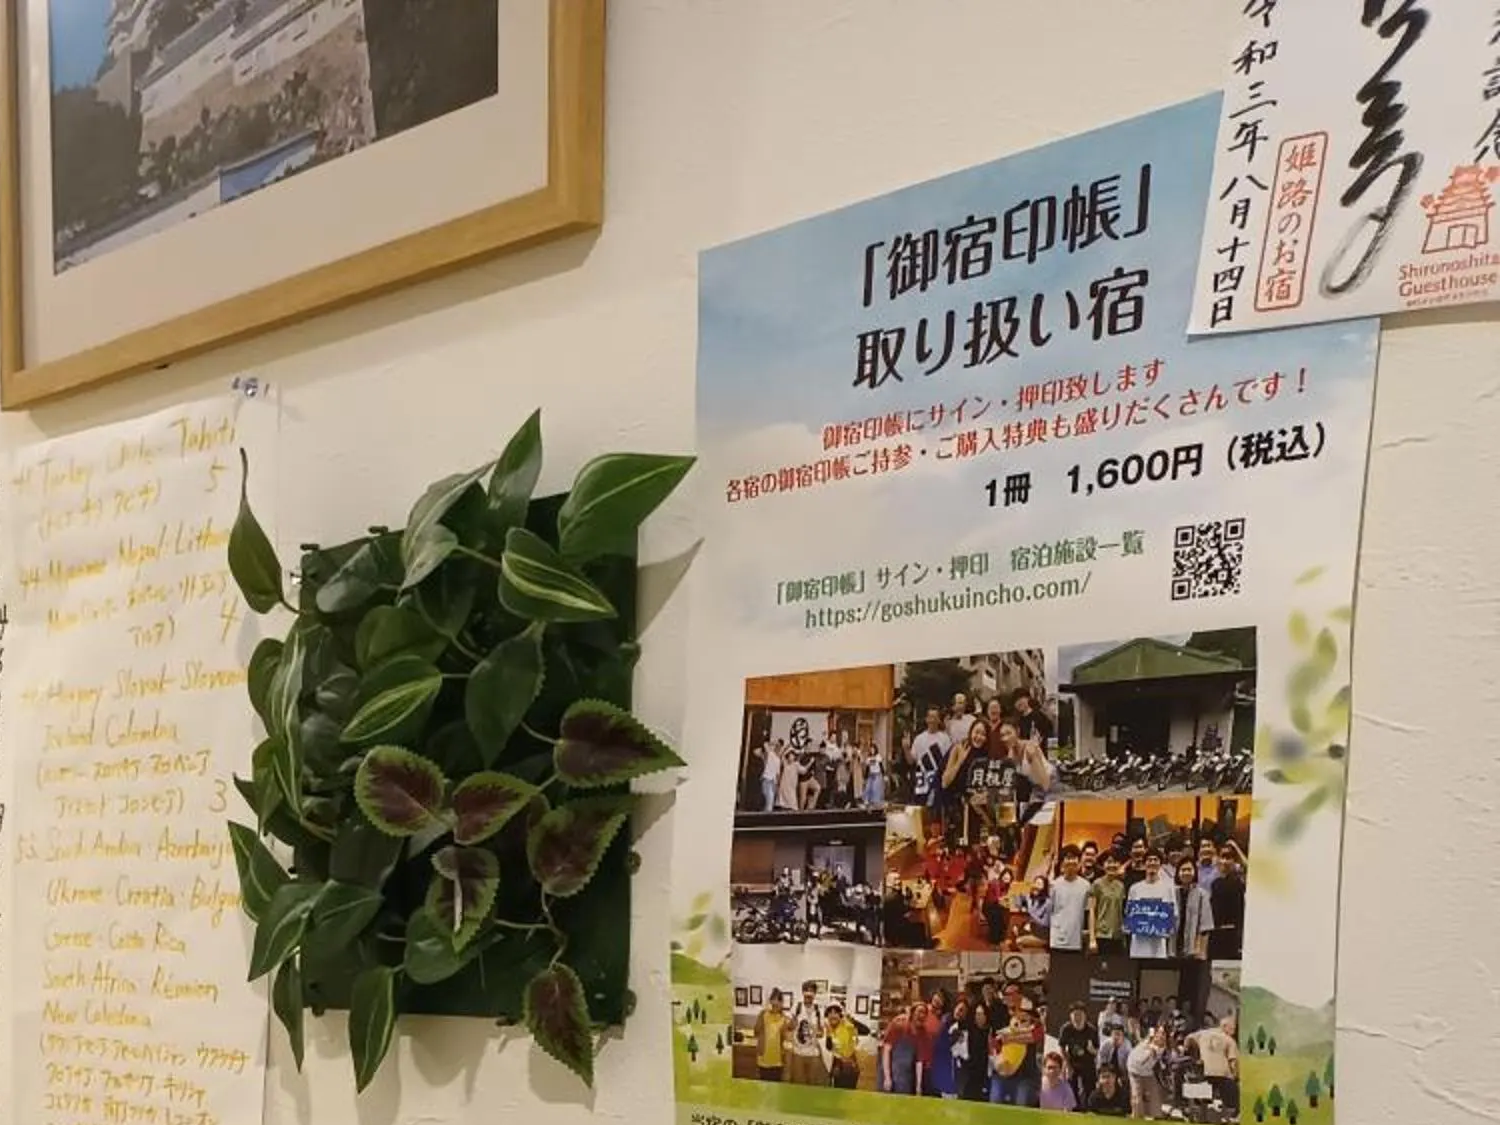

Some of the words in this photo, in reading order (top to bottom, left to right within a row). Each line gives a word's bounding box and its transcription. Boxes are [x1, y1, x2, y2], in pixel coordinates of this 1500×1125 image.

[861, 162, 1155, 310] 「御宿印帳」
[1264, 140, 1318, 303] 姫路のお宿
[1399, 272, 1498, 298] Guesthouse
[852, 265, 1152, 391] 取り扱い宿
[984, 470, 1032, 509] 1冊
[804, 571, 1093, 630] https://goshukuincho.com/
[207, 779, 228, 813] 3
